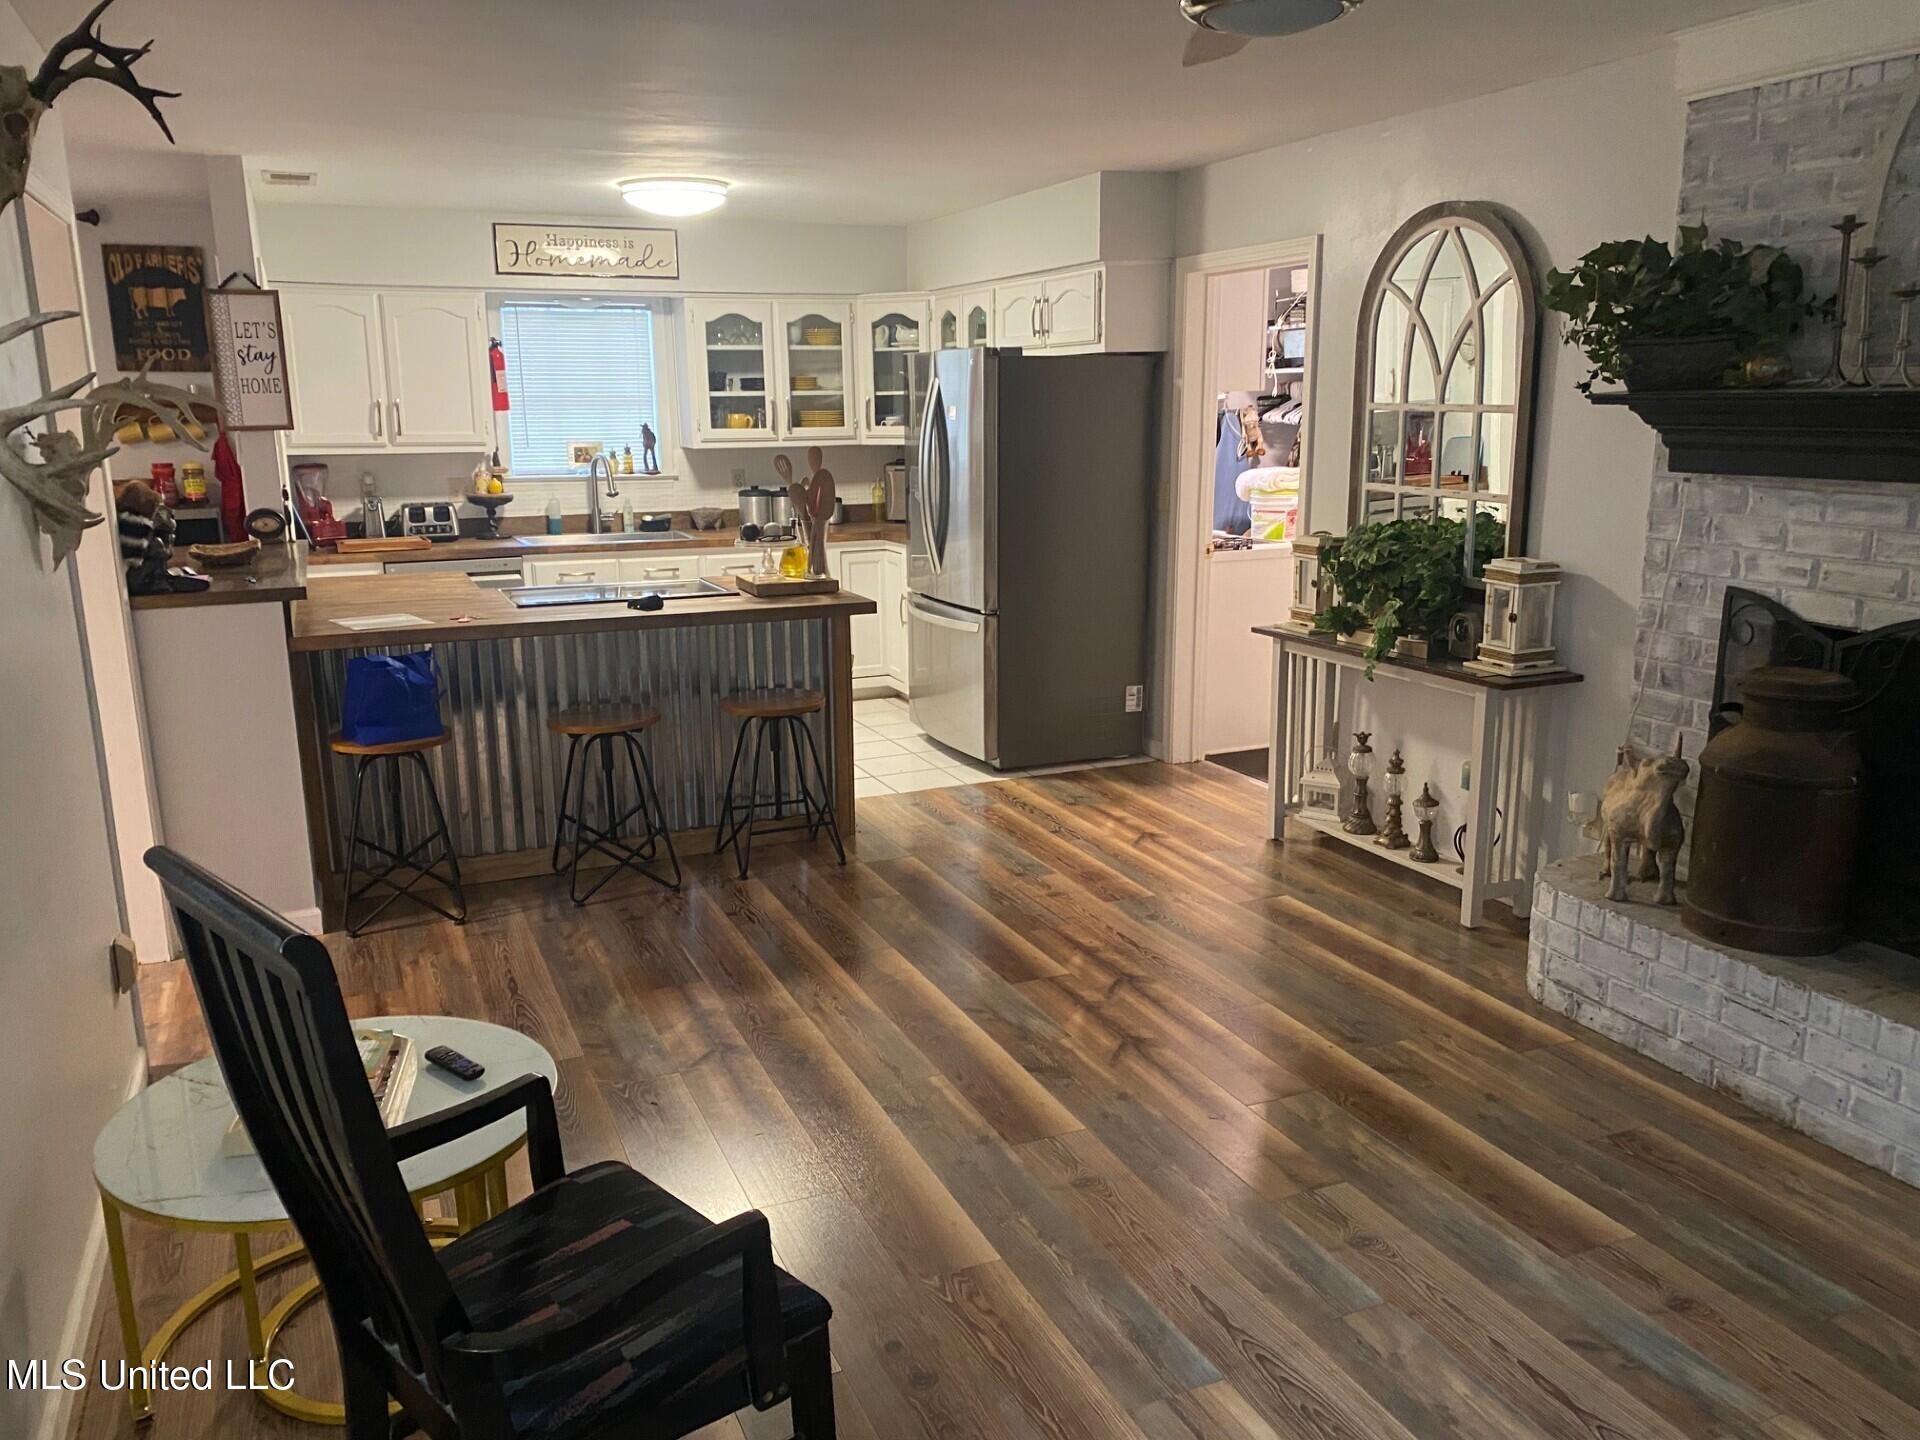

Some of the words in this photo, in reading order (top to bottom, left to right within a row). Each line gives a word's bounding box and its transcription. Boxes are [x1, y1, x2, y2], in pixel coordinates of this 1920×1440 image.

[545, 233, 619, 250] Happiness
[623, 236, 634, 249] is
[505, 239, 672, 270] Homemade
[108, 253, 133, 285] OLD
[234, 321, 277, 340] LET'S
[136, 348, 192, 361] FOOD
[237, 345, 276, 375] stay
[240, 377, 282, 394] HOME
